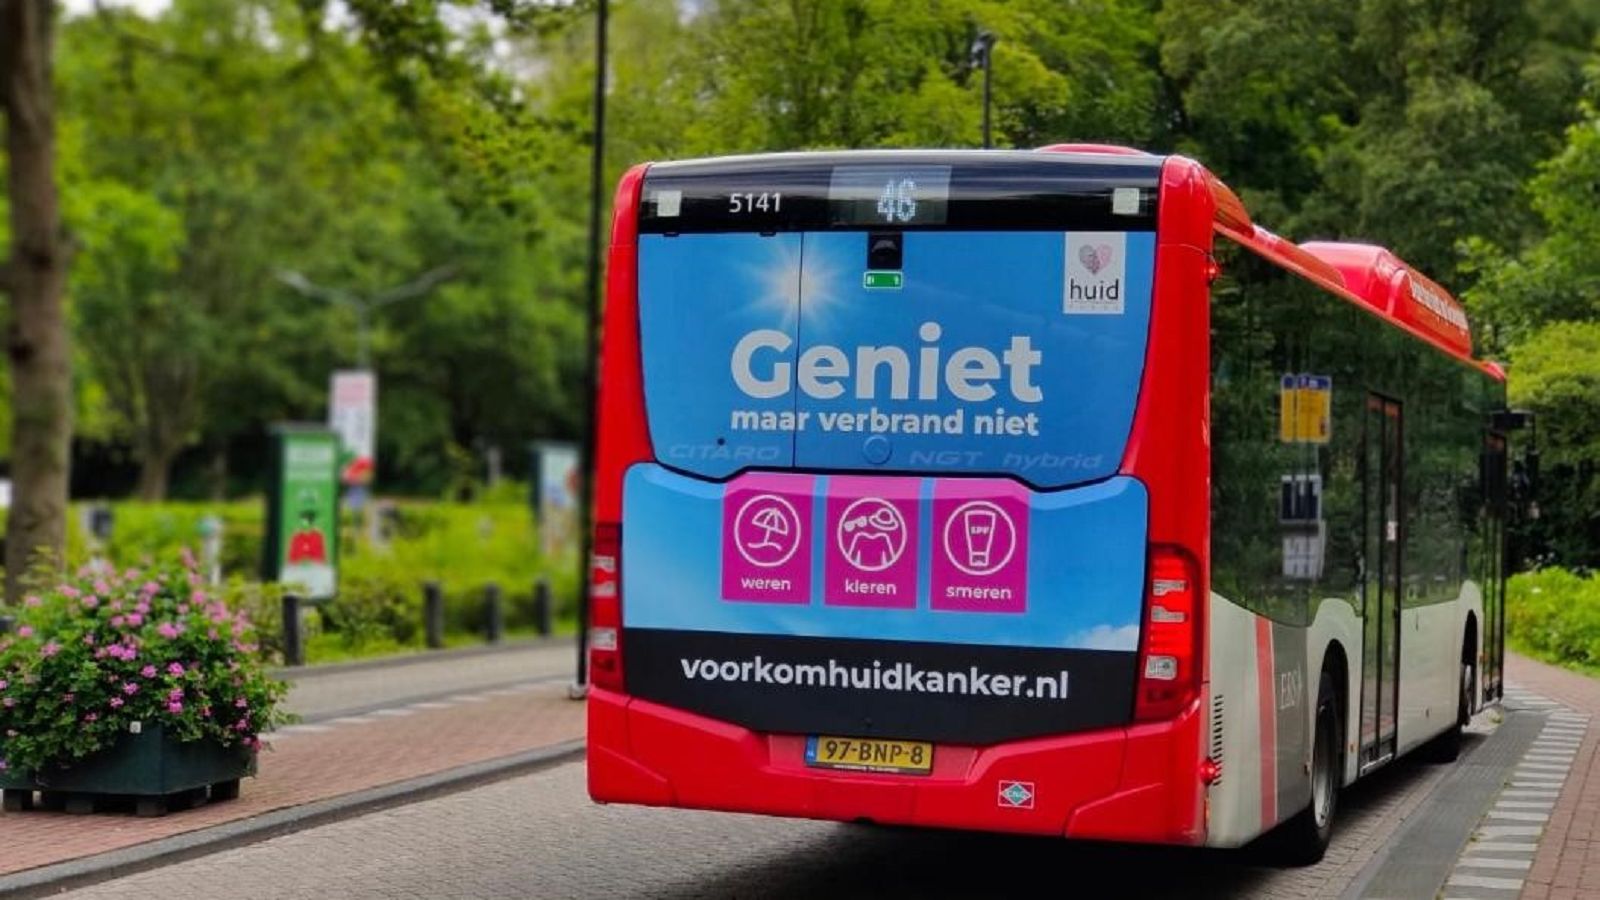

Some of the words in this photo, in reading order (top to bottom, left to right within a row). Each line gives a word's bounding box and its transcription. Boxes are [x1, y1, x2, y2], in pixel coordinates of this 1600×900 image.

[729, 192, 781, 213] 5141
[877, 178, 916, 222] 46
[1070, 278, 1119, 300] huid
[731, 322, 1043, 403] Geniet
[731, 408, 809, 431] maar
[819, 408, 964, 435] verbrand
[974, 409, 1039, 437] niet
[669, 444, 780, 461] CITARO
[909, 450, 983, 465] NGT
[1002, 453, 1103, 470] hybrid
[741, 578, 791, 591] weren
[845, 580, 897, 596] kleren
[946, 586, 1012, 600] smeren
[681, 655, 1069, 700] voorkomhuidkanker.nl
[825, 740, 924, 766] 97-BNP-8
